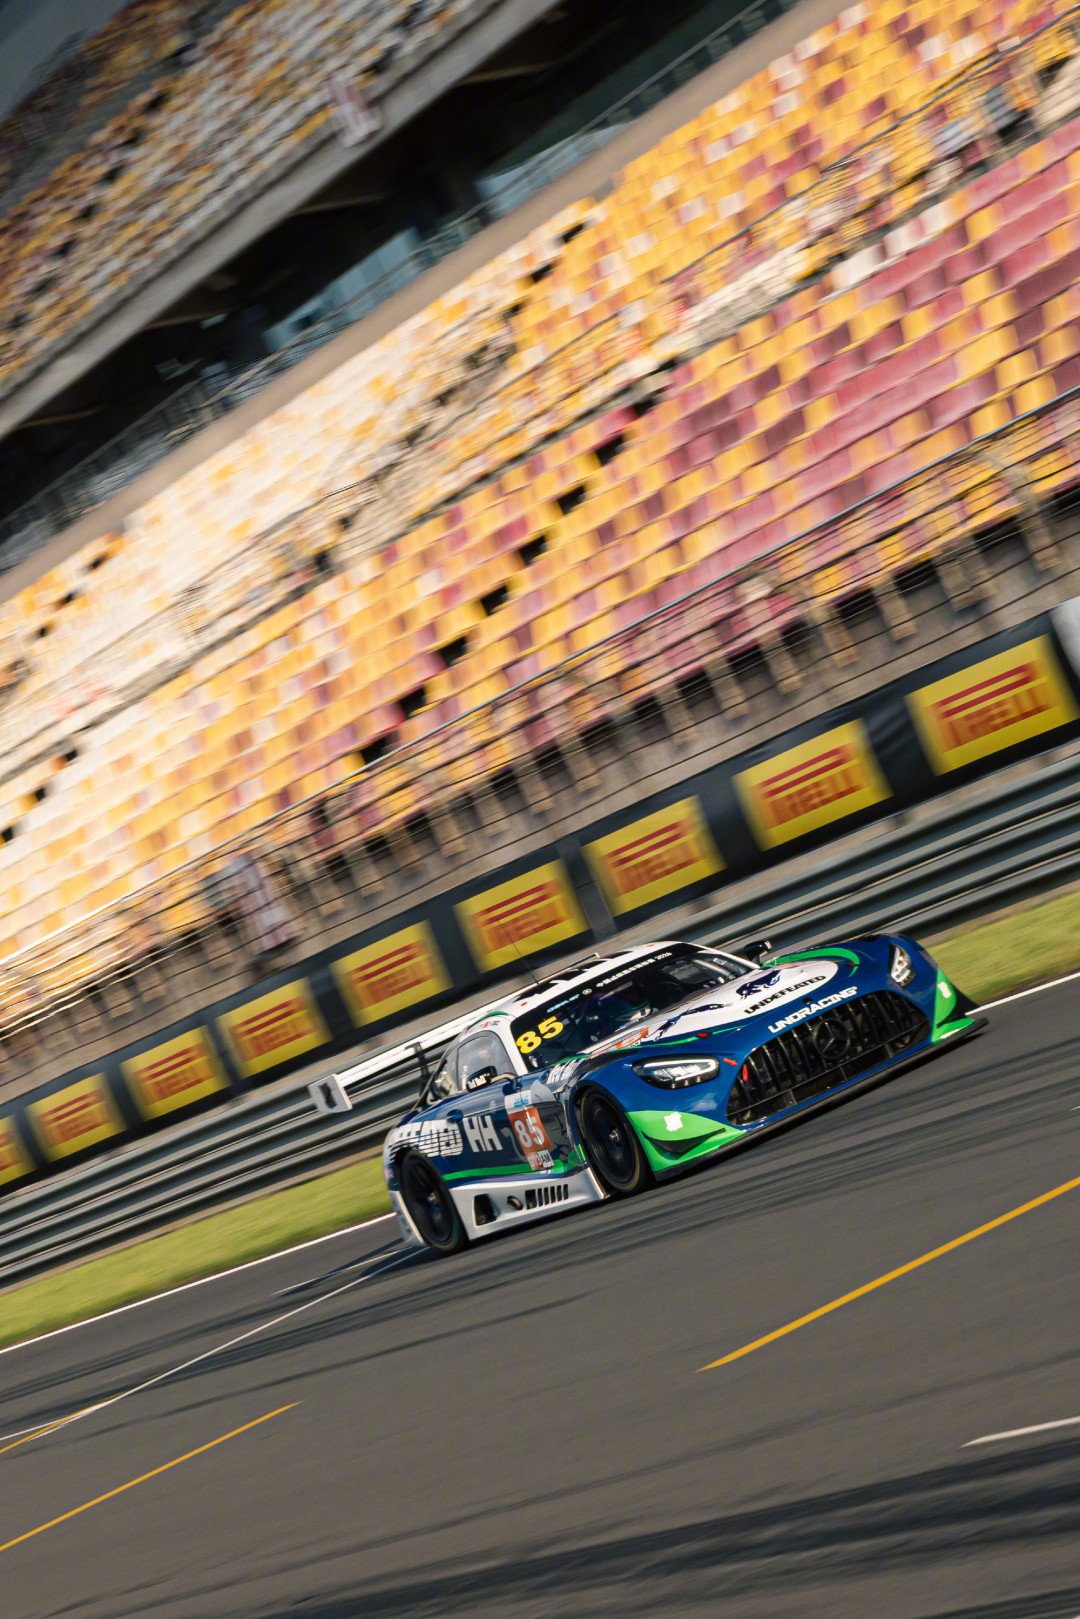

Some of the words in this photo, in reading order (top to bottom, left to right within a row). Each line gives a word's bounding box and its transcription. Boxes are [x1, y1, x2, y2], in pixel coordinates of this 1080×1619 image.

[744, 975, 826, 1014] UNDEFEATED
[516, 1015, 564, 1054] 85
[514, 1116, 545, 1148] 85
